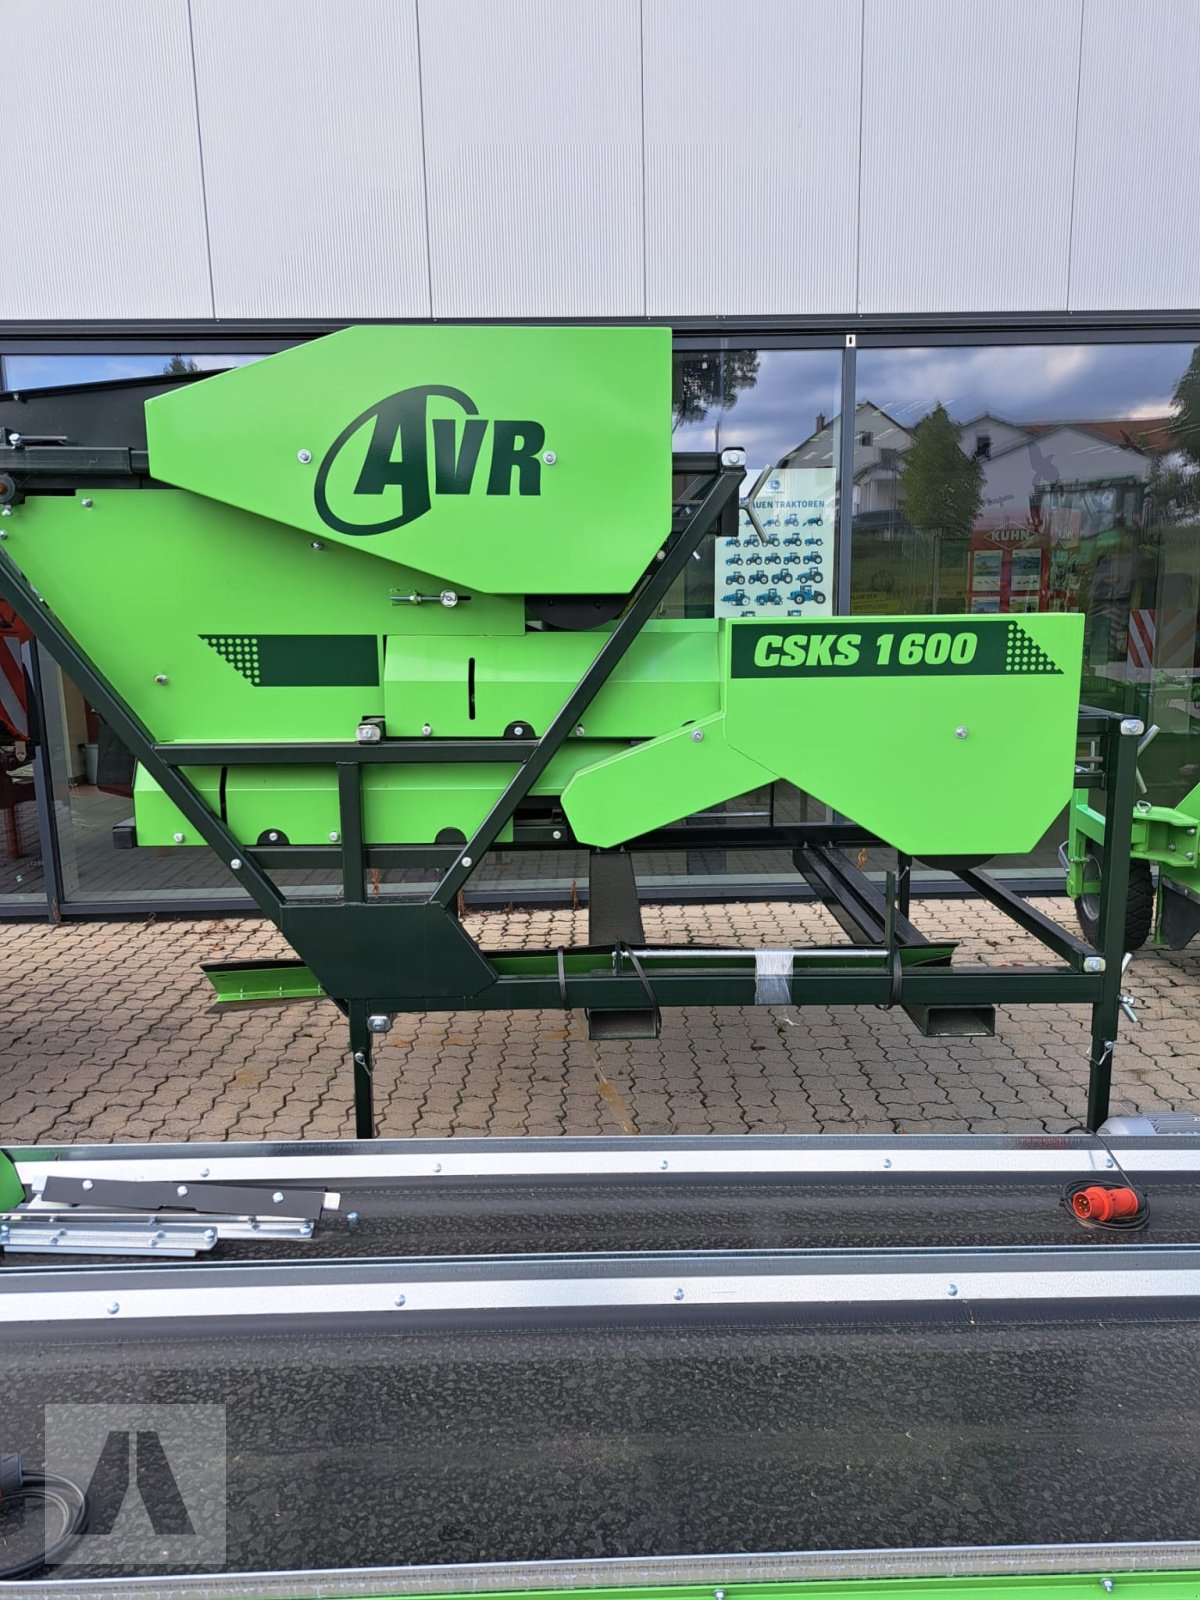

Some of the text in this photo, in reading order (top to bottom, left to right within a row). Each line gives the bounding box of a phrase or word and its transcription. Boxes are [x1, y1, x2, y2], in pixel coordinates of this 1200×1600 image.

[345, 386, 546, 530] AVR
[775, 500, 825, 508] TRAKTOREN
[991, 529, 1030, 541] KUHN
[753, 632, 978, 667] CSKS 1600
